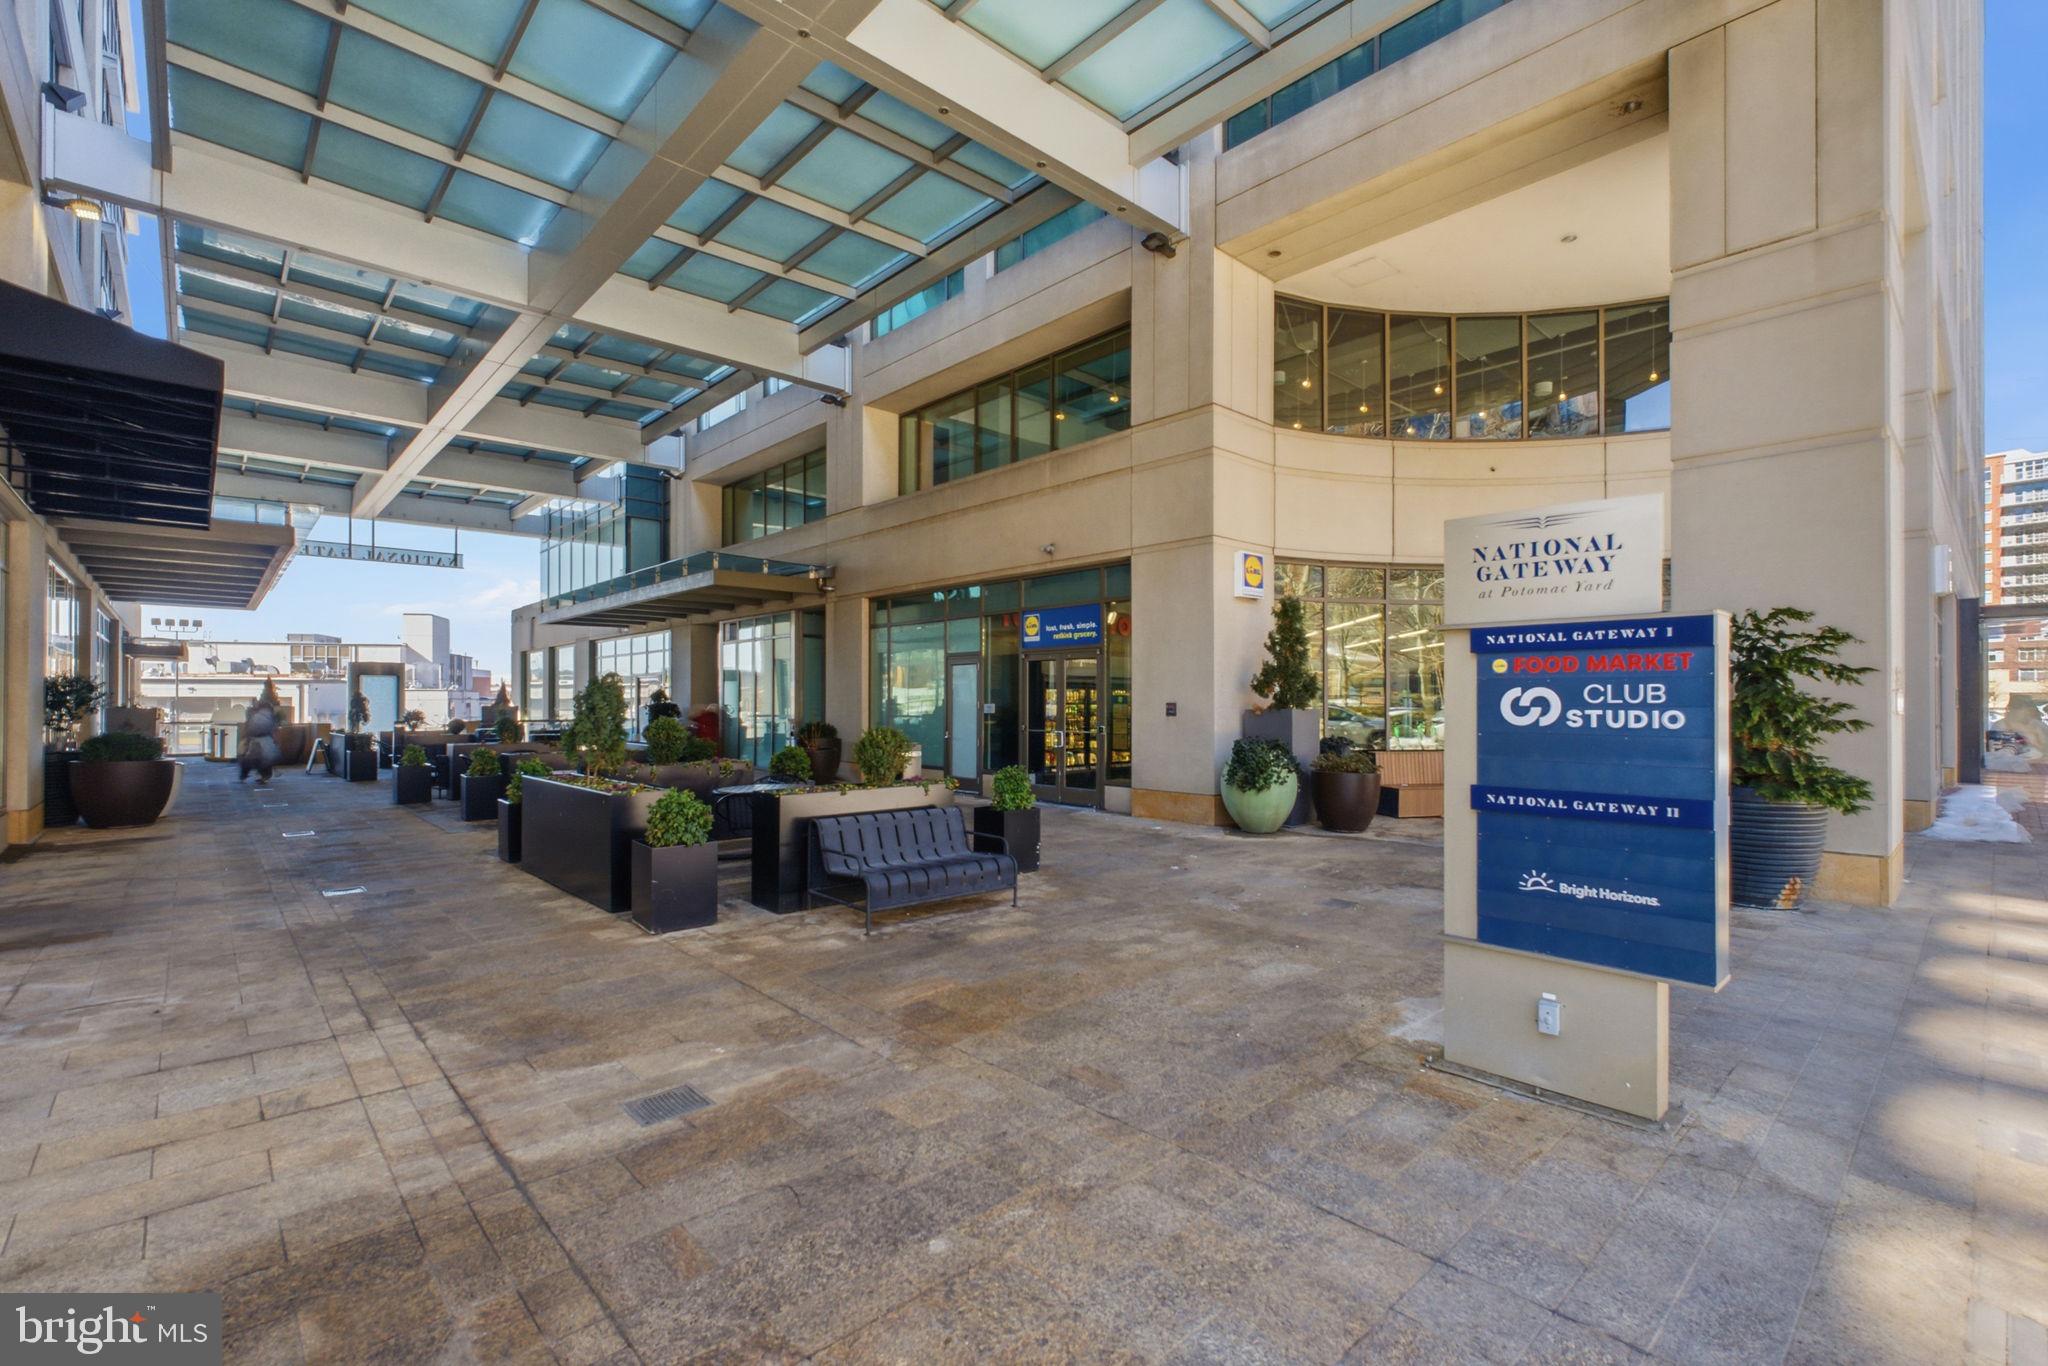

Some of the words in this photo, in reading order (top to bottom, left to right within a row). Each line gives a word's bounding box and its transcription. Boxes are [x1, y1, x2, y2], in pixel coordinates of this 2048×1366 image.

[1472, 533, 1623, 563] NATIONAL
[1476, 555, 1616, 583] GATEWAY
[1478, 589, 1493, 599] at
[1501, 584, 1568, 598] Potomac
[1575, 579, 1614, 593] Yard
[1486, 633, 1567, 645] NATIONAL
[1572, 627, 1658, 641] GATEWAY
[1666, 626, 1673, 637] I
[1513, 655, 1579, 673] FOOD
[1586, 652, 1694, 672] MARKET
[1583, 683, 1667, 704] CLUB
[1565, 709, 1686, 730] STUDIO
[1486, 793, 1568, 809] NATIONAL
[1572, 800, 1659, 817] GATEWAY
[1666, 807, 1680, 818] II
[1559, 882, 1598, 899] Bright
